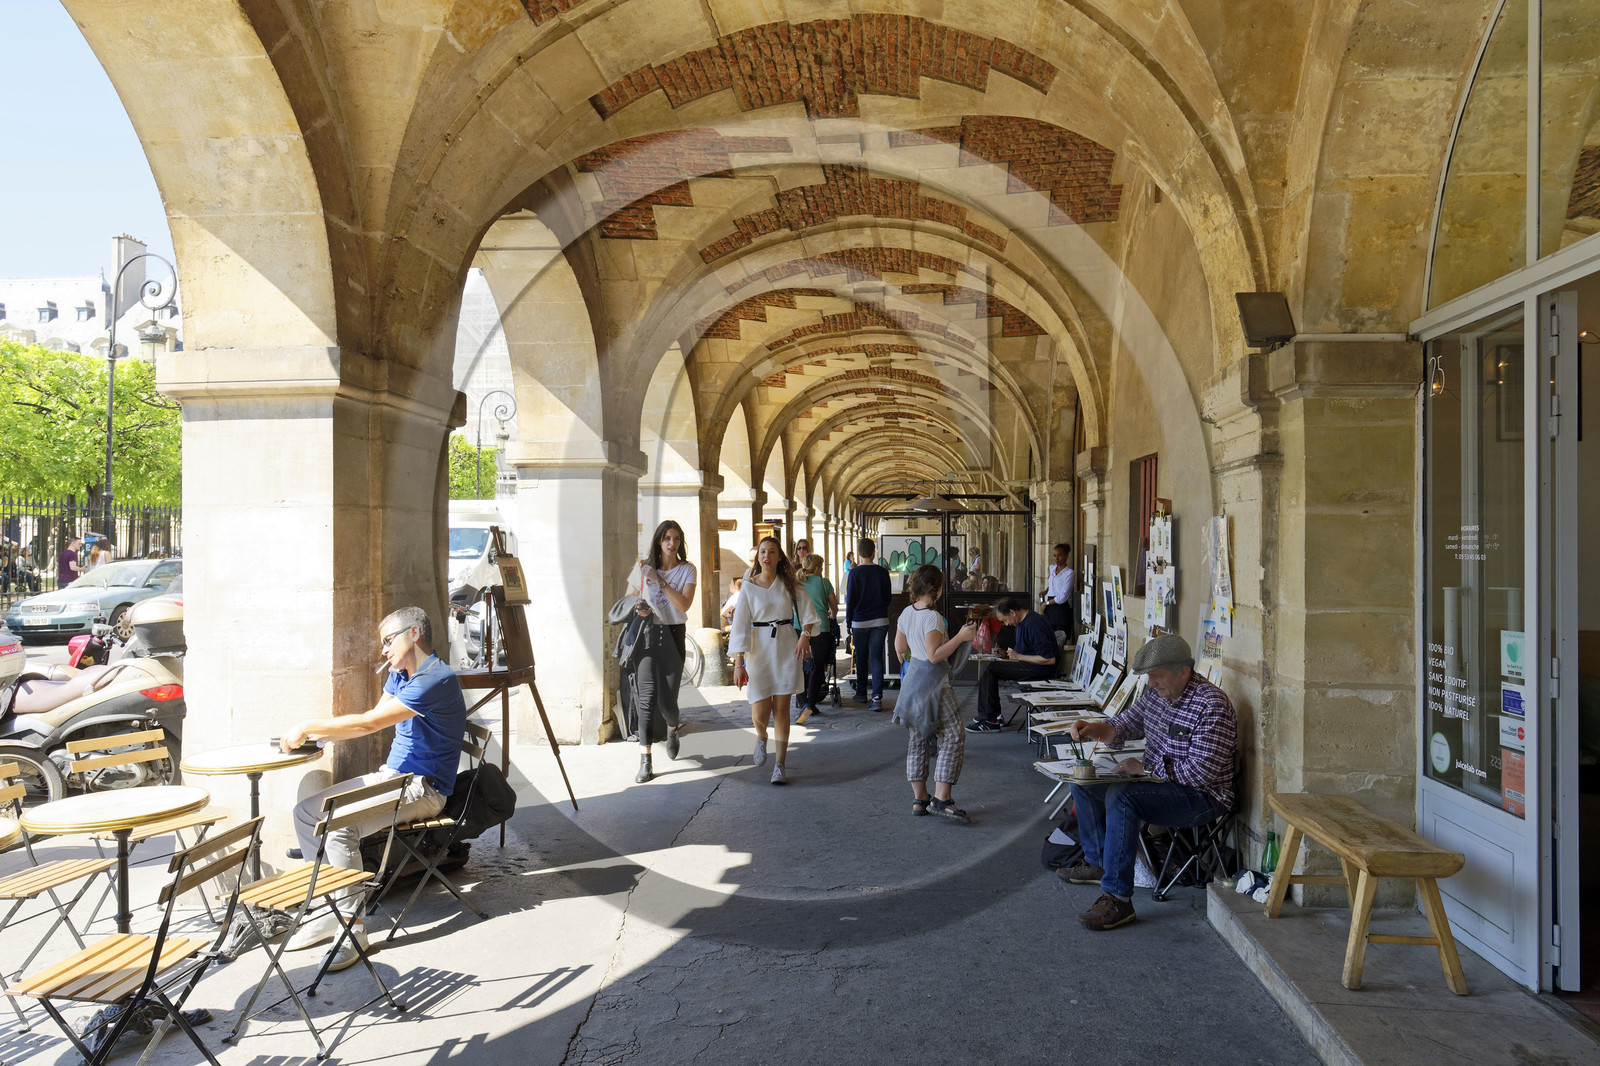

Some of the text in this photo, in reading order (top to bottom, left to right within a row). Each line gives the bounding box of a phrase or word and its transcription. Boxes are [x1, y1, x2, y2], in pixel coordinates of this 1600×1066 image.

[1429, 355, 1445, 397] 25
[1428, 643, 1454, 656] 100% BIO
[1428, 657, 1447, 669] VEGAN
[1428, 671, 1467, 689] SANS ADDITIF
[1428, 686, 1441, 697] NON
[1428, 700, 1470, 721] 100% NATUREL
